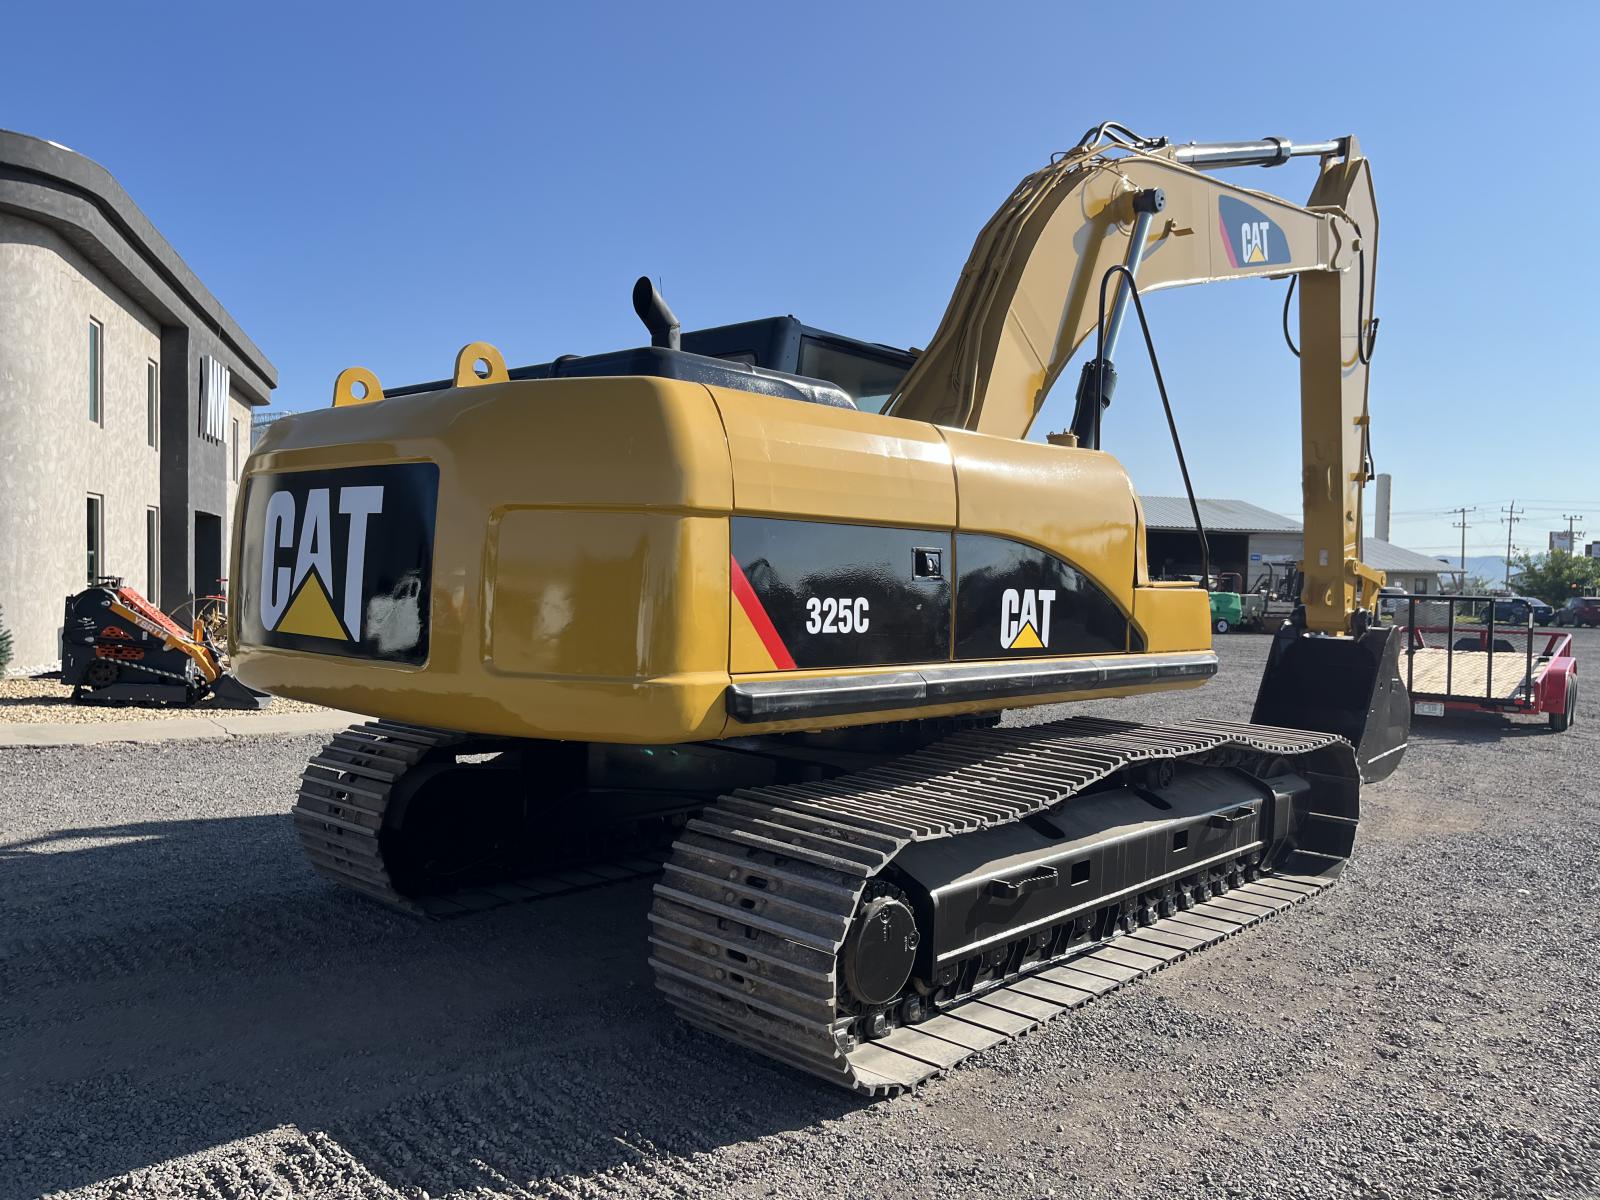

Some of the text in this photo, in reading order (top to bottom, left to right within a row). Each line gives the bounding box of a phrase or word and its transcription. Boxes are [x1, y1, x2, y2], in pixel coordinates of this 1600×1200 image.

[1241, 222, 1269, 263] CAT
[261, 486, 384, 642] CAT
[806, 597, 870, 634] 325C
[1000, 588, 1056, 650] CAT
